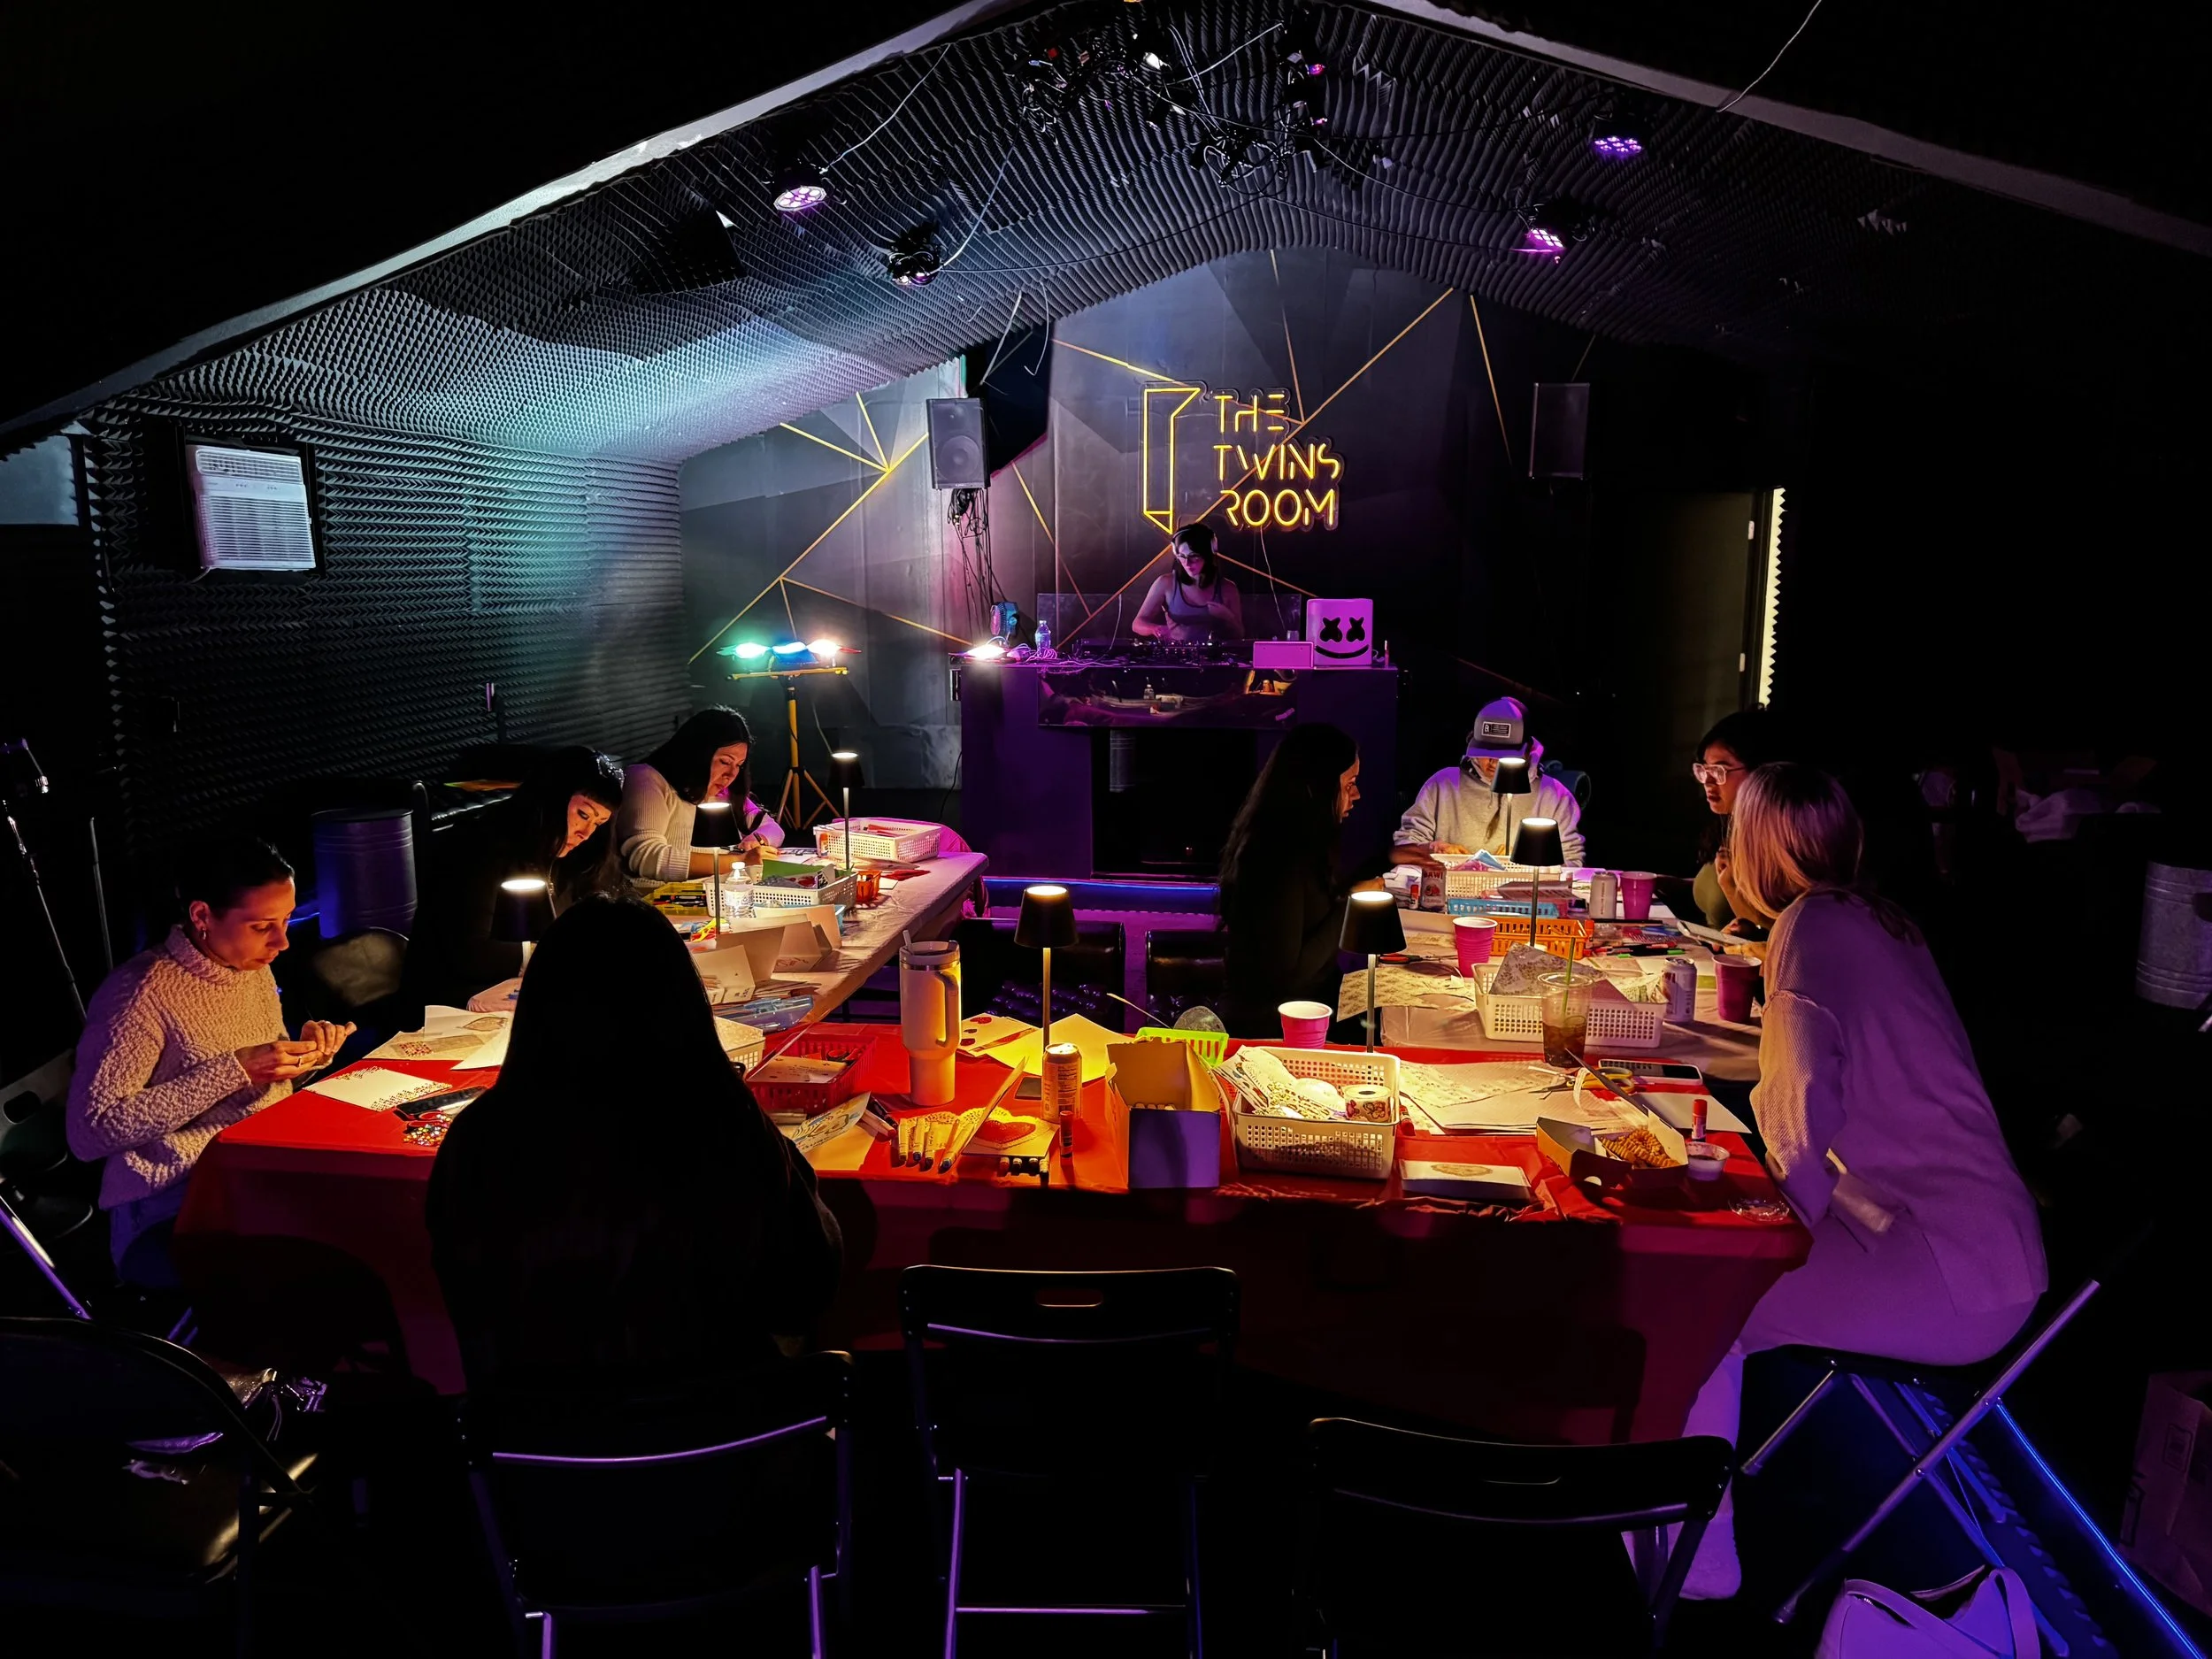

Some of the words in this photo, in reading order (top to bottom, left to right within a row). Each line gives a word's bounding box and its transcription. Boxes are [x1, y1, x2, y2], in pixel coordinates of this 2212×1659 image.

[1214, 394, 1284, 433] THE
[1213, 443, 1340, 480] TWINS
[1220, 488, 1334, 526] ROOM
